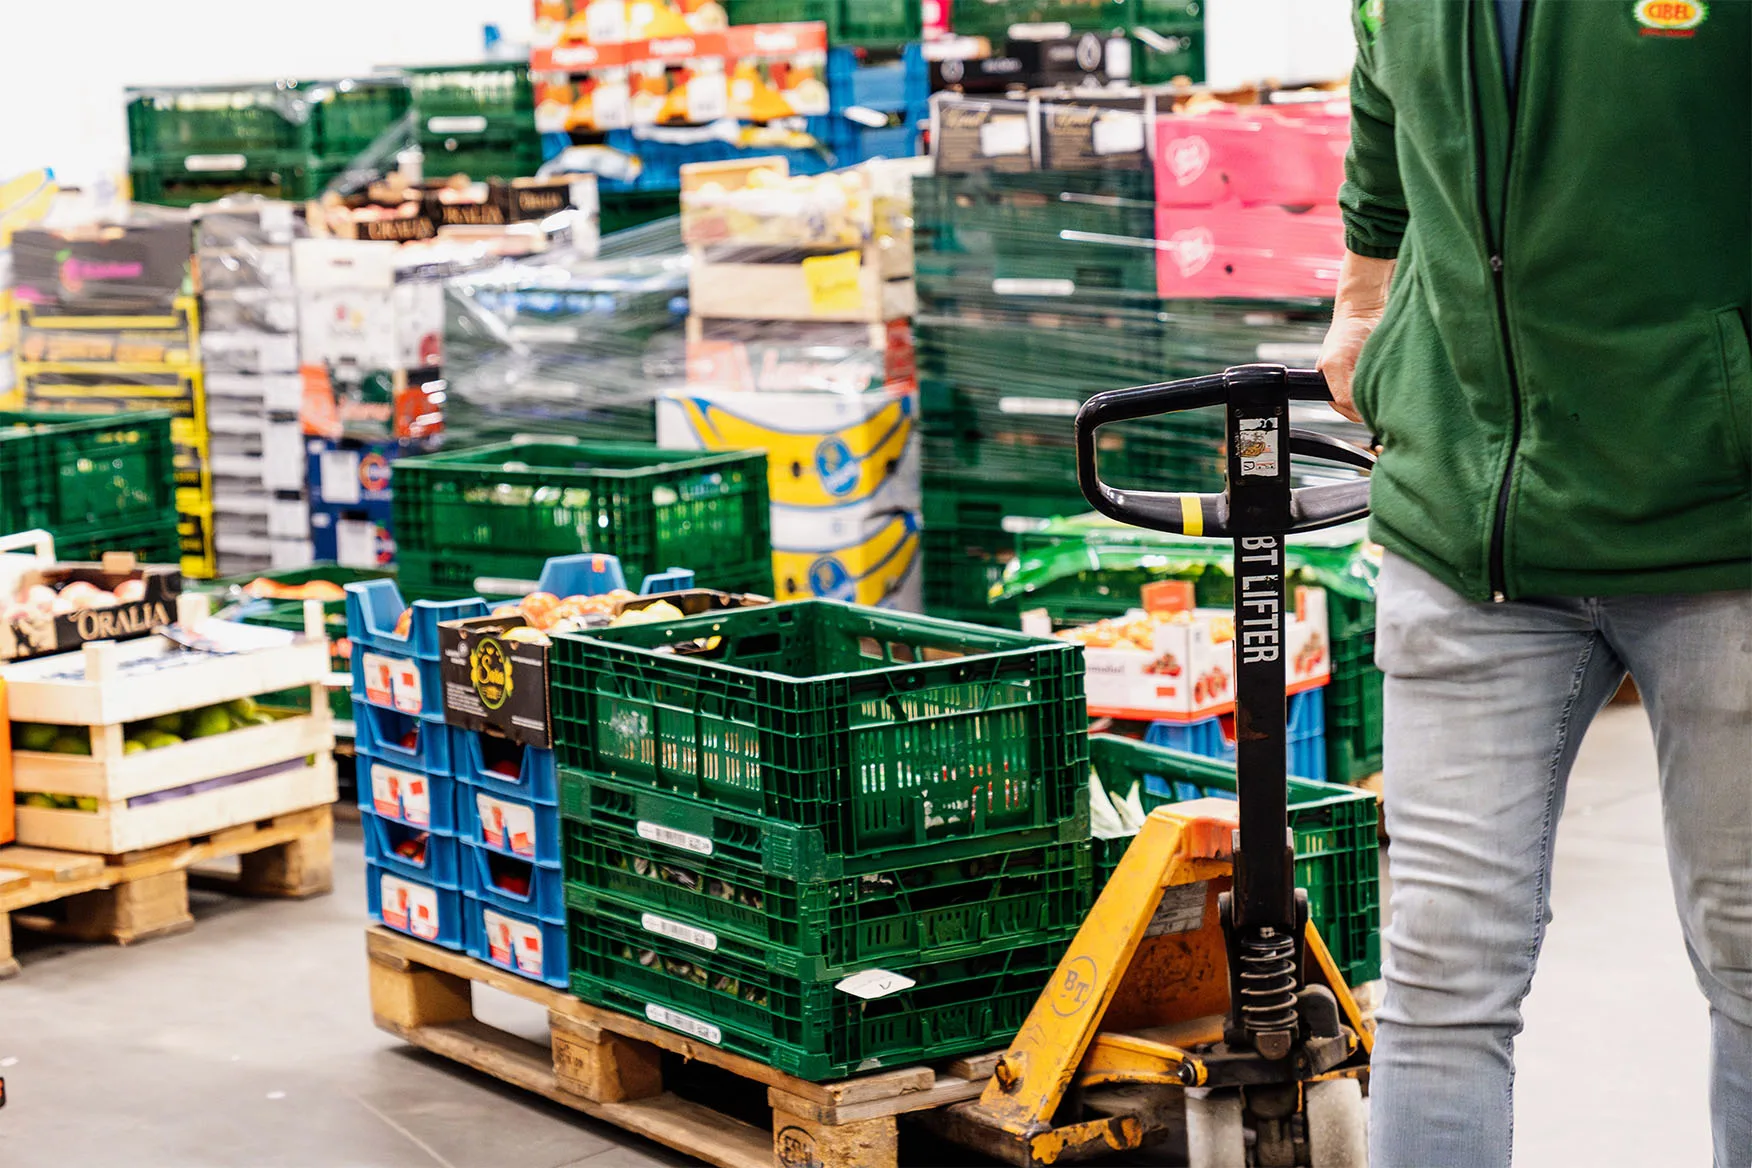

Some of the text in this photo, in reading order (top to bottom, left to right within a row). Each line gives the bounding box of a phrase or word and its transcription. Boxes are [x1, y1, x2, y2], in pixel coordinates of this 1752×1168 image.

[1647, 3, 1691, 20] CIBEL
[1242, 536, 1280, 664] BT LIFTER
[67, 601, 171, 641] ORALIA
[1063, 969, 1091, 1003] BT
